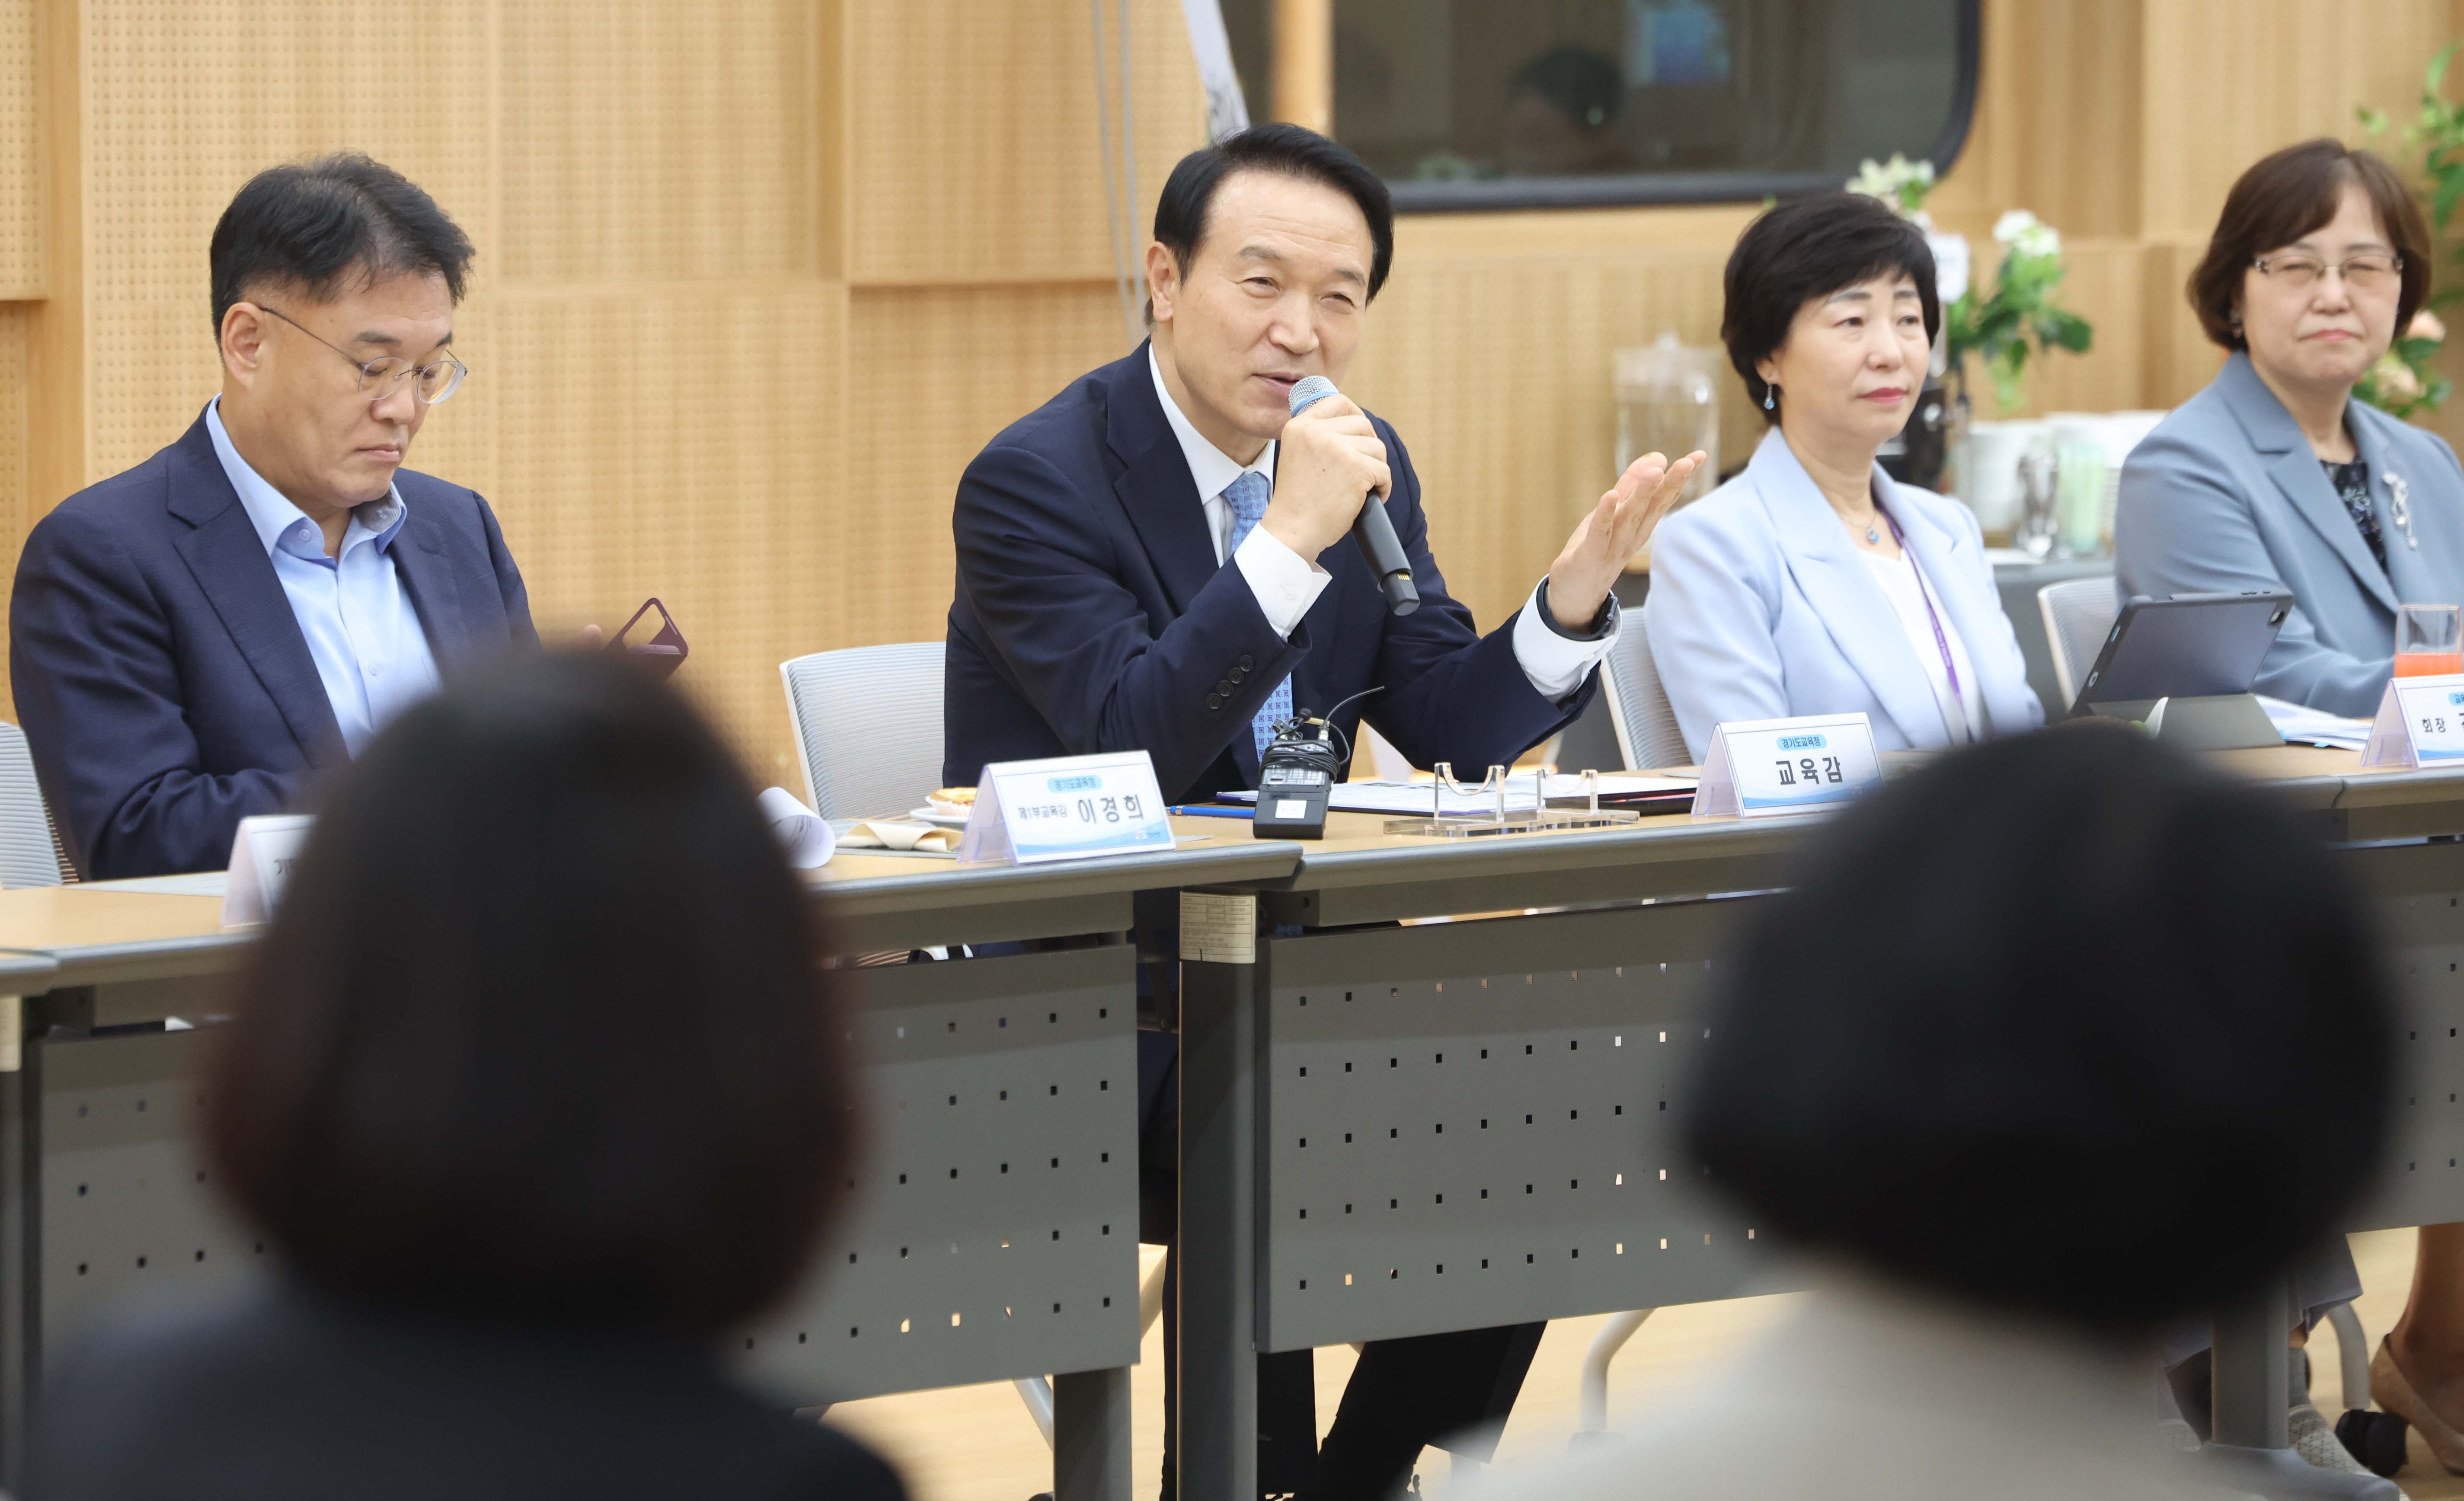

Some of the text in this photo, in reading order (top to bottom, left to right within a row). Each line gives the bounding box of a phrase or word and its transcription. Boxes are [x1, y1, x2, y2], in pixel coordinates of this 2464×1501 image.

[2421, 717, 2446, 733] 회장
[1782, 737, 1821, 749] 경기도교육청
[1776, 756, 1843, 785] 교육감
[1055, 776, 1096, 791] 경기도교육청
